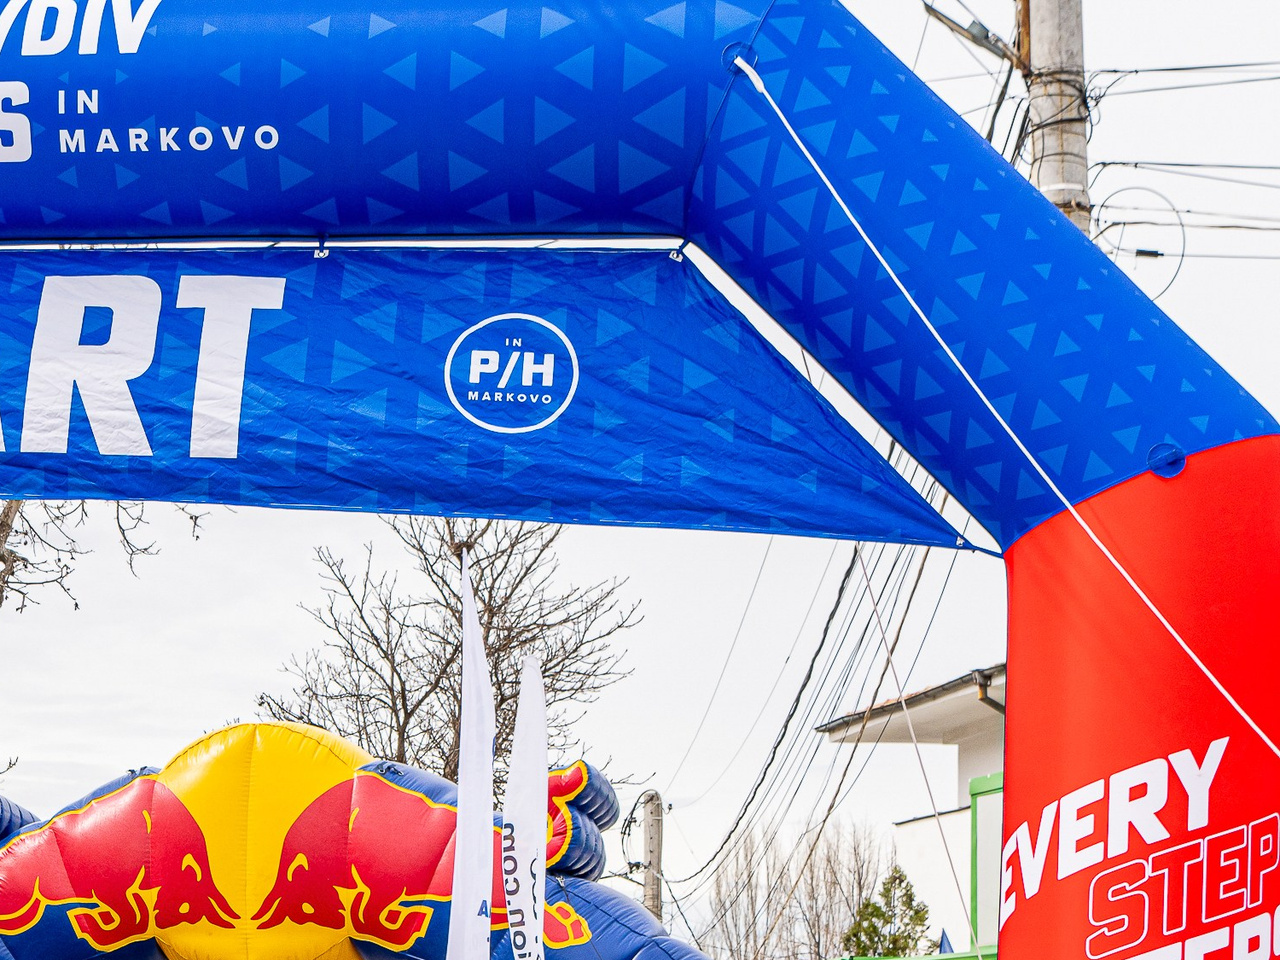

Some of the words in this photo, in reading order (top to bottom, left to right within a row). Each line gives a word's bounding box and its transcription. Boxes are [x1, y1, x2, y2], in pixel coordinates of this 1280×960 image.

[58, 89, 100, 115] IN
[58, 125, 281, 154] MARKOVO
[505, 337, 523, 347] IN
[468, 349, 555, 389] P/H
[467, 391, 552, 404] MARKOVO
[999, 735, 1231, 932] EVERY
[1085, 811, 1280, 960] STEP
